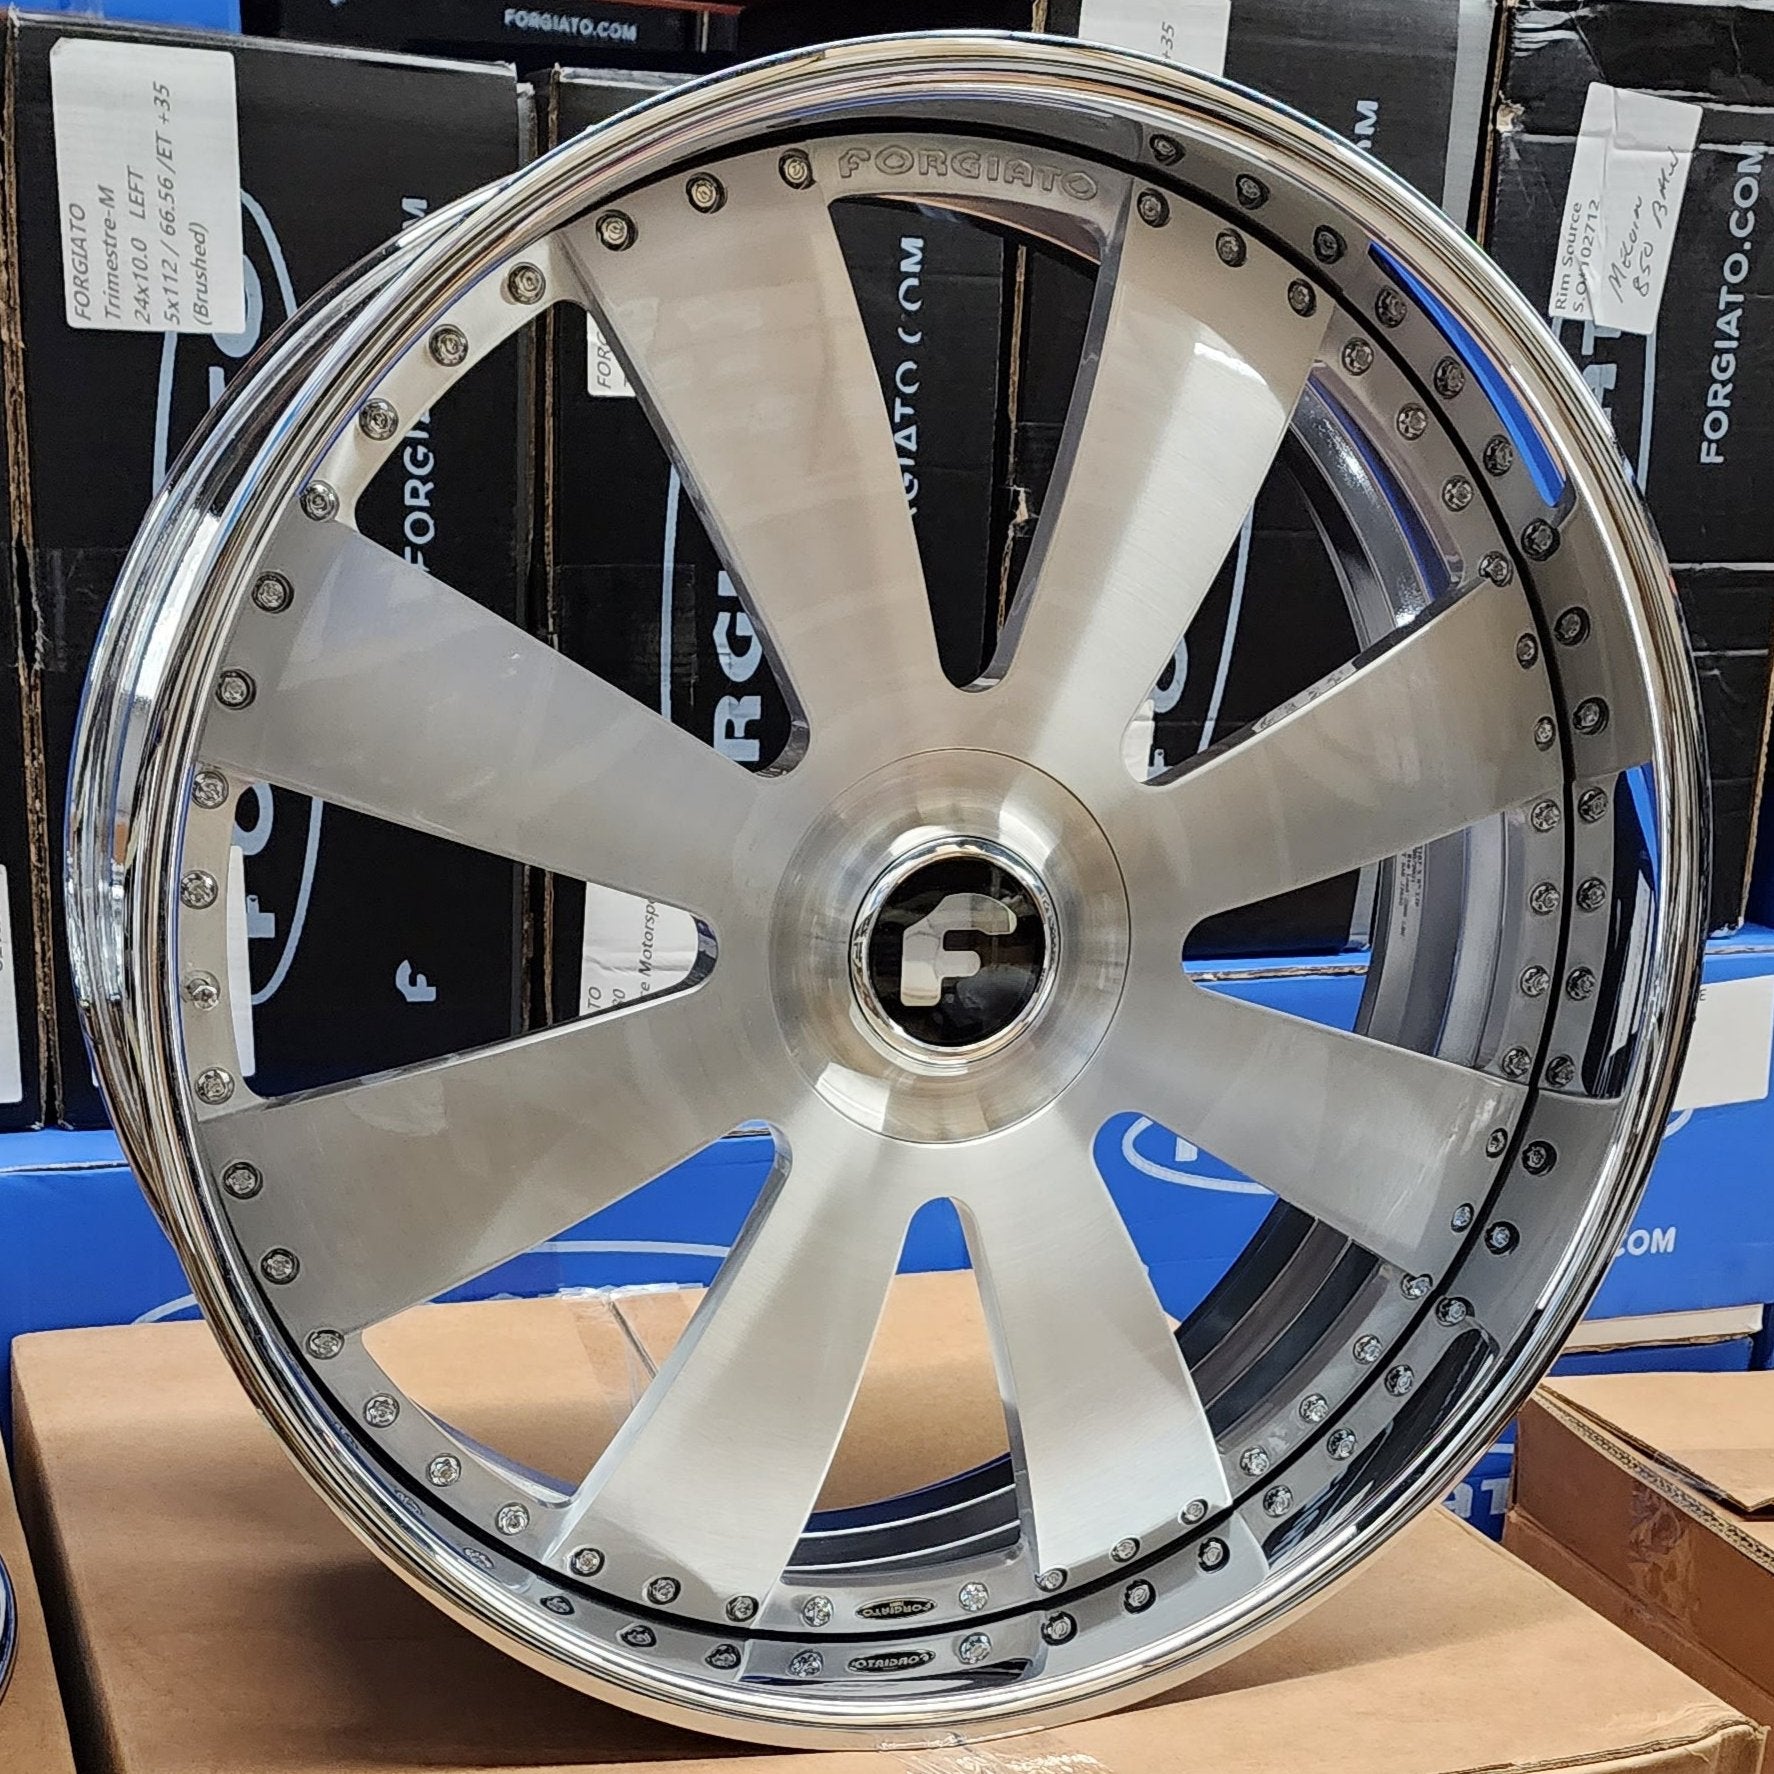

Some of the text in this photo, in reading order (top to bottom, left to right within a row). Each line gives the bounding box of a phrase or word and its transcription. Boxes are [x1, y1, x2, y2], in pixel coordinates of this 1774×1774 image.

[503, 8, 637, 42] FORGIATO.COM
[153, 81, 171, 125] +35
[838, 145, 1098, 201] FORGIATO
[69, 203, 92, 321] FORGIATO
[97, 184, 121, 320] Trimestre-M
[127, 165, 151, 324] 24x10.0 LEFT
[162, 259, 180, 325] 5x112
[188, 222, 213, 326] (Brushed)
[1555, 202, 1582, 310] Rim Source
[1700, 144, 1767, 464] FORGIATO.COM
